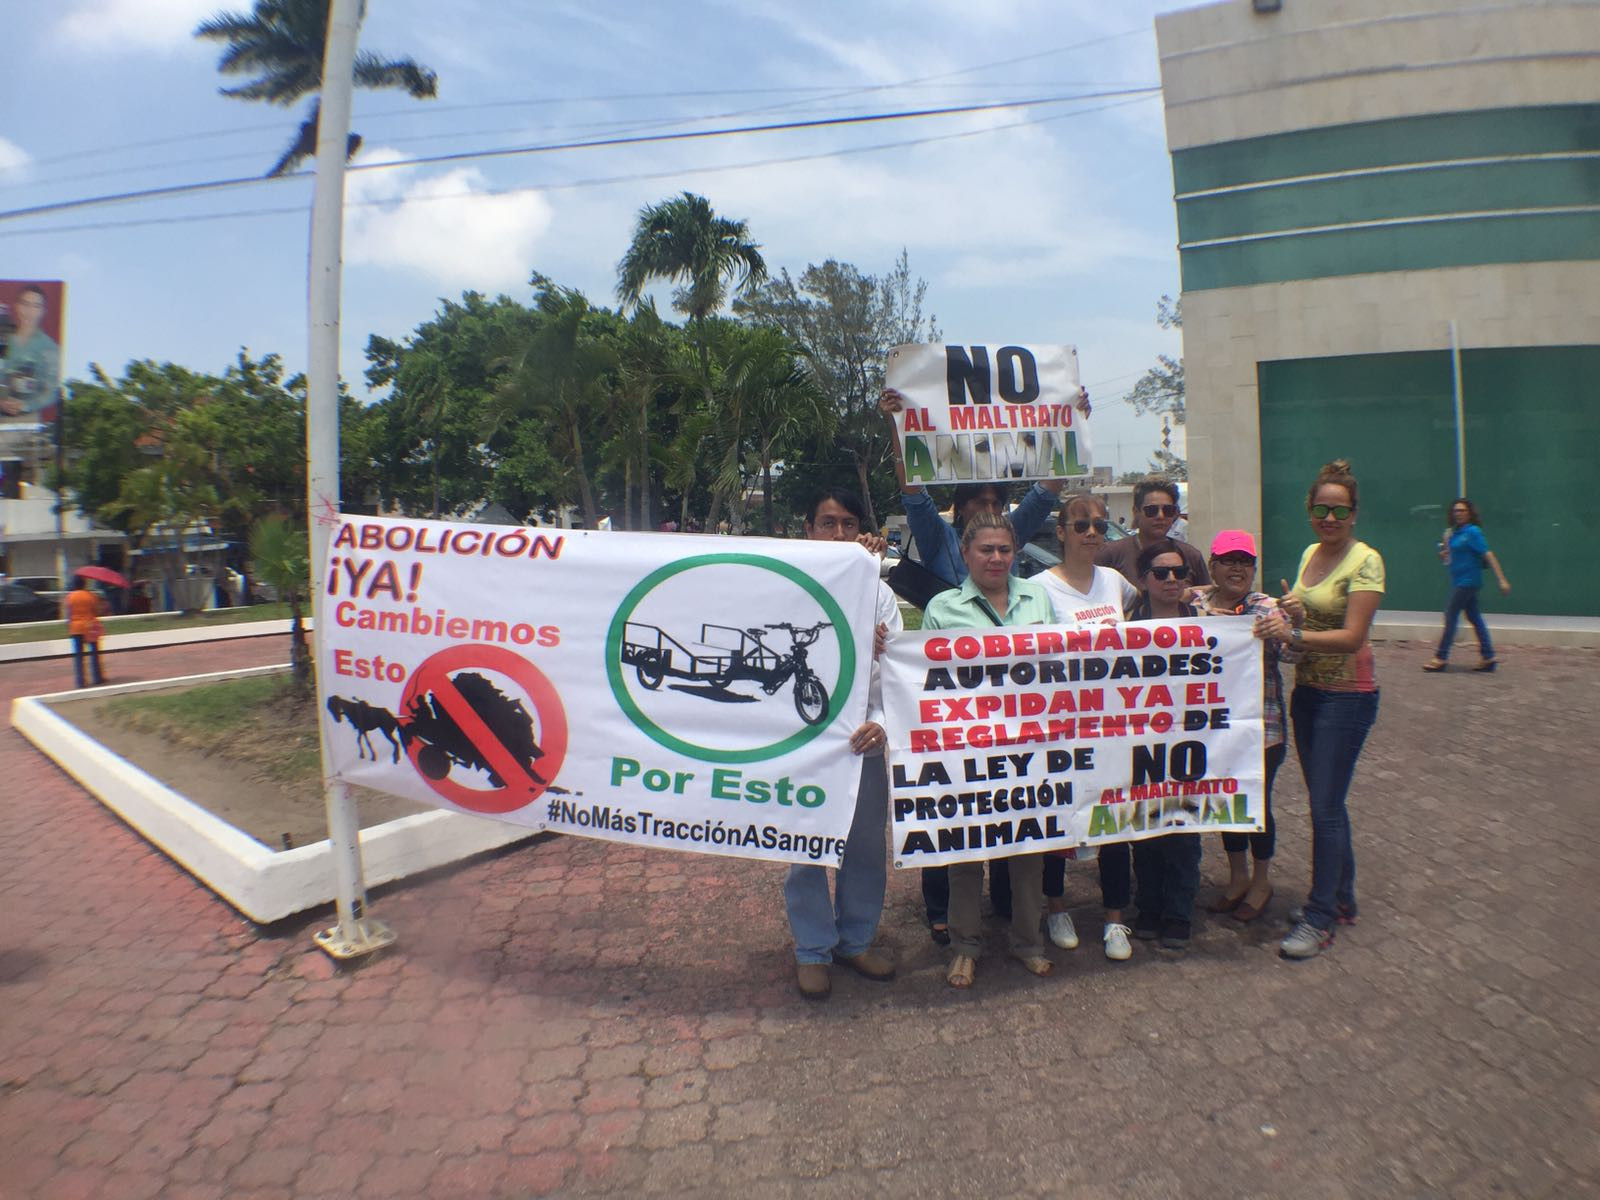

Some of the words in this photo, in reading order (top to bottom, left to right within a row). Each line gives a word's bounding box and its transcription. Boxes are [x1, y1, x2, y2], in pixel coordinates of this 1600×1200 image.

[945, 346, 1040, 405] NO
[905, 407, 937, 432] AL
[950, 405, 1072, 430] MALTRATO
[905, 431, 1088, 482] ANIMAL
[334, 523, 565, 560] ABOLICIÓN
[327, 556, 423, 602] ¡YA!
[336, 601, 561, 647] Cambiemos
[1075, 605, 1116, 621] ABOLICIÓN
[924, 625, 1218, 661] GOBERNADOR,
[334, 649, 406, 683] Esto
[924, 653, 1224, 691] AUTORIDADES:
[919, 687, 1104, 724] EXPIDAN
[1117, 684, 1173, 710] YA
[1185, 682, 1226, 706] EL
[910, 711, 1174, 753] REGLAMENTO
[1184, 708, 1230, 731] DE
[610, 756, 694, 794] Por
[711, 768, 826, 808] Esto
[893, 761, 951, 788] LA
[964, 752, 1034, 782] LEY
[1047, 747, 1094, 773] DE
[1132, 741, 1207, 785] NO
[895, 779, 1073, 822] PROTECCIÓN
[1100, 788, 1126, 804] AL
[1130, 778, 1238, 801] MALTRATO
[547, 799, 846, 859] #NoMásTracciónASangre
[901, 816, 1065, 855] ANIMAL
[1088, 794, 1255, 837] ANIMAL
